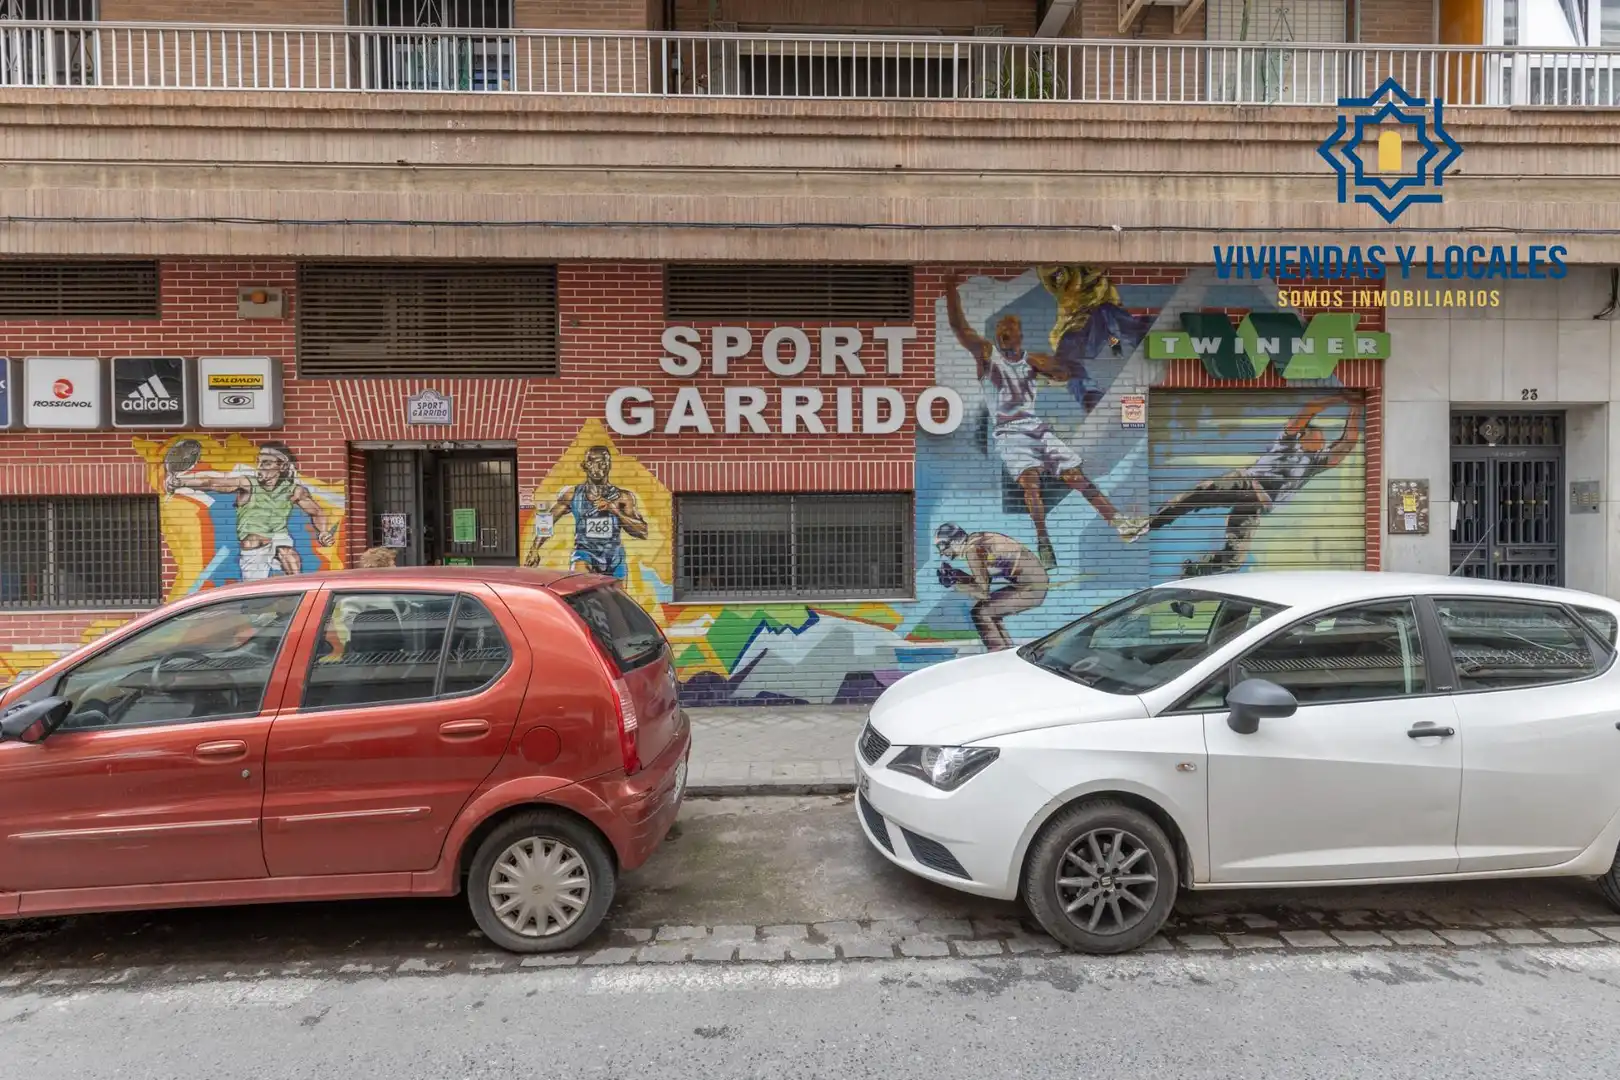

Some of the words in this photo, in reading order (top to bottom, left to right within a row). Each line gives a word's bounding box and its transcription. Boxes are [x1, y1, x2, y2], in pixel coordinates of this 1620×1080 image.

[658, 325, 917, 377] SPORT
[1162, 336, 1379, 355] TWINNER
[1521, 389, 1539, 401] 23
[32, 400, 93, 408] ROSSIGNOL
[121, 397, 179, 411] adidas
[417, 401, 444, 410] SPORT
[412, 409, 448, 417] GARRIDO
[604, 386, 964, 436] GARRIDO
[587, 520, 610, 533] 268
